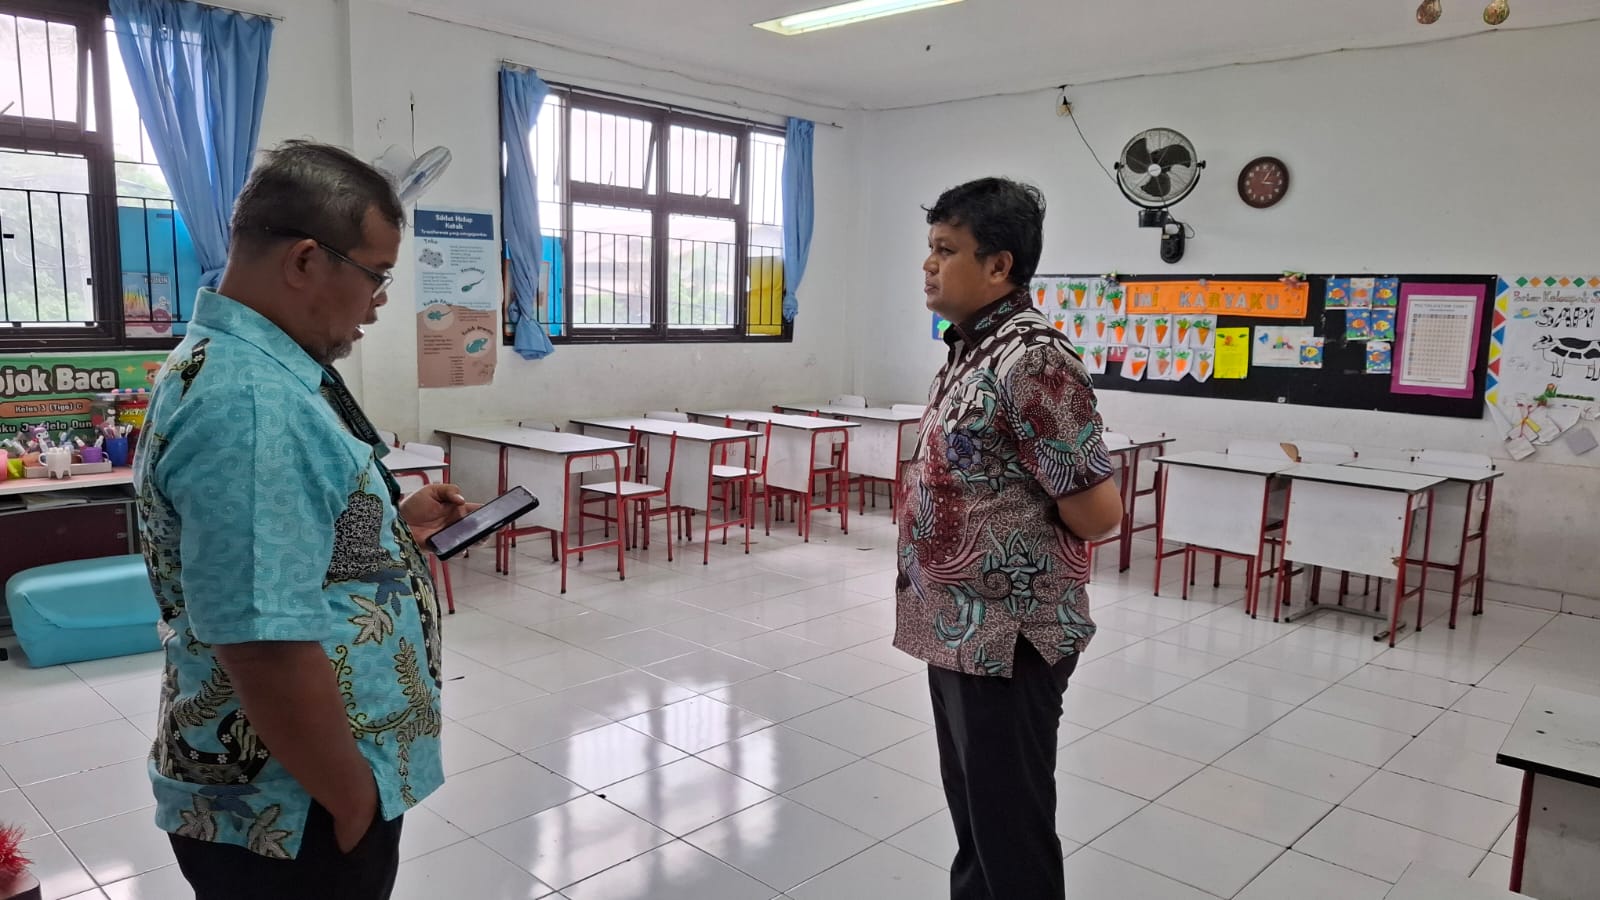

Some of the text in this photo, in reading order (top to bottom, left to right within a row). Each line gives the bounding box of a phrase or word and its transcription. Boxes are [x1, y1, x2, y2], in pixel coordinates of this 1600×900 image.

[1179, 291, 1280, 310] KARYAKU
[1535, 305, 1595, 329] SAPI
[55, 367, 116, 391] Baca
[0, 423, 16, 433] ku
[71, 419, 92, 429] Dun
